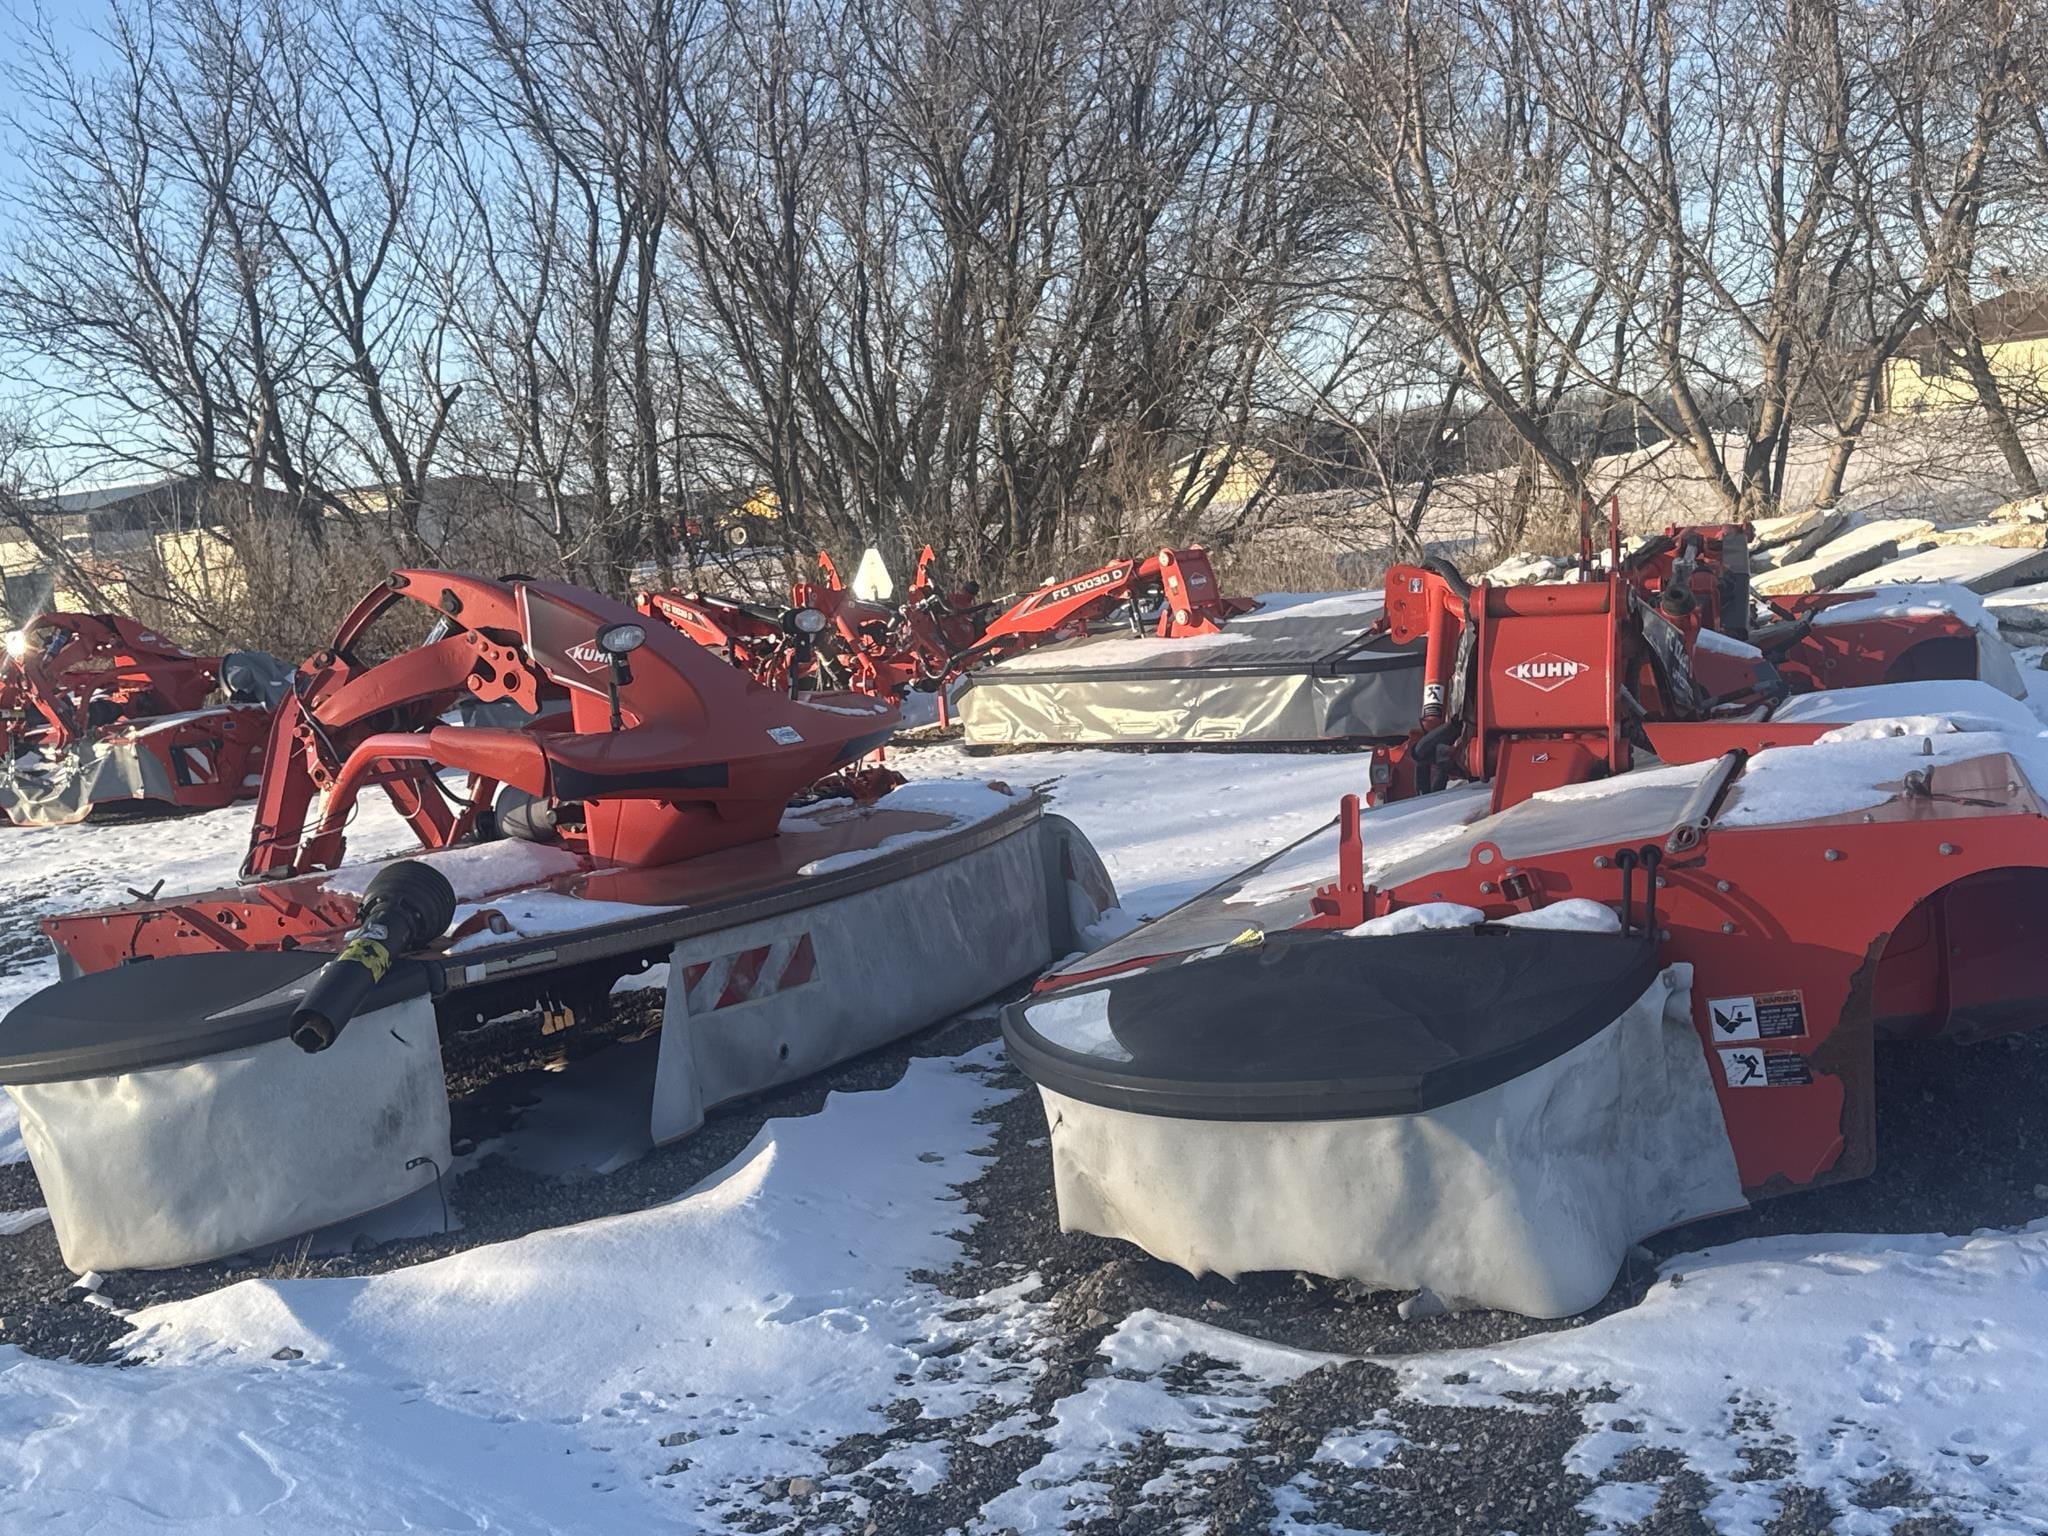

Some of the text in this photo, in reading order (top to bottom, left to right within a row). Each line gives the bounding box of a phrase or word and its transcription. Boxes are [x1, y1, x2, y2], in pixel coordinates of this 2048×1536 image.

[1052, 569, 1123, 601] FC 10030 D
[1517, 662, 1578, 678] KUHN
